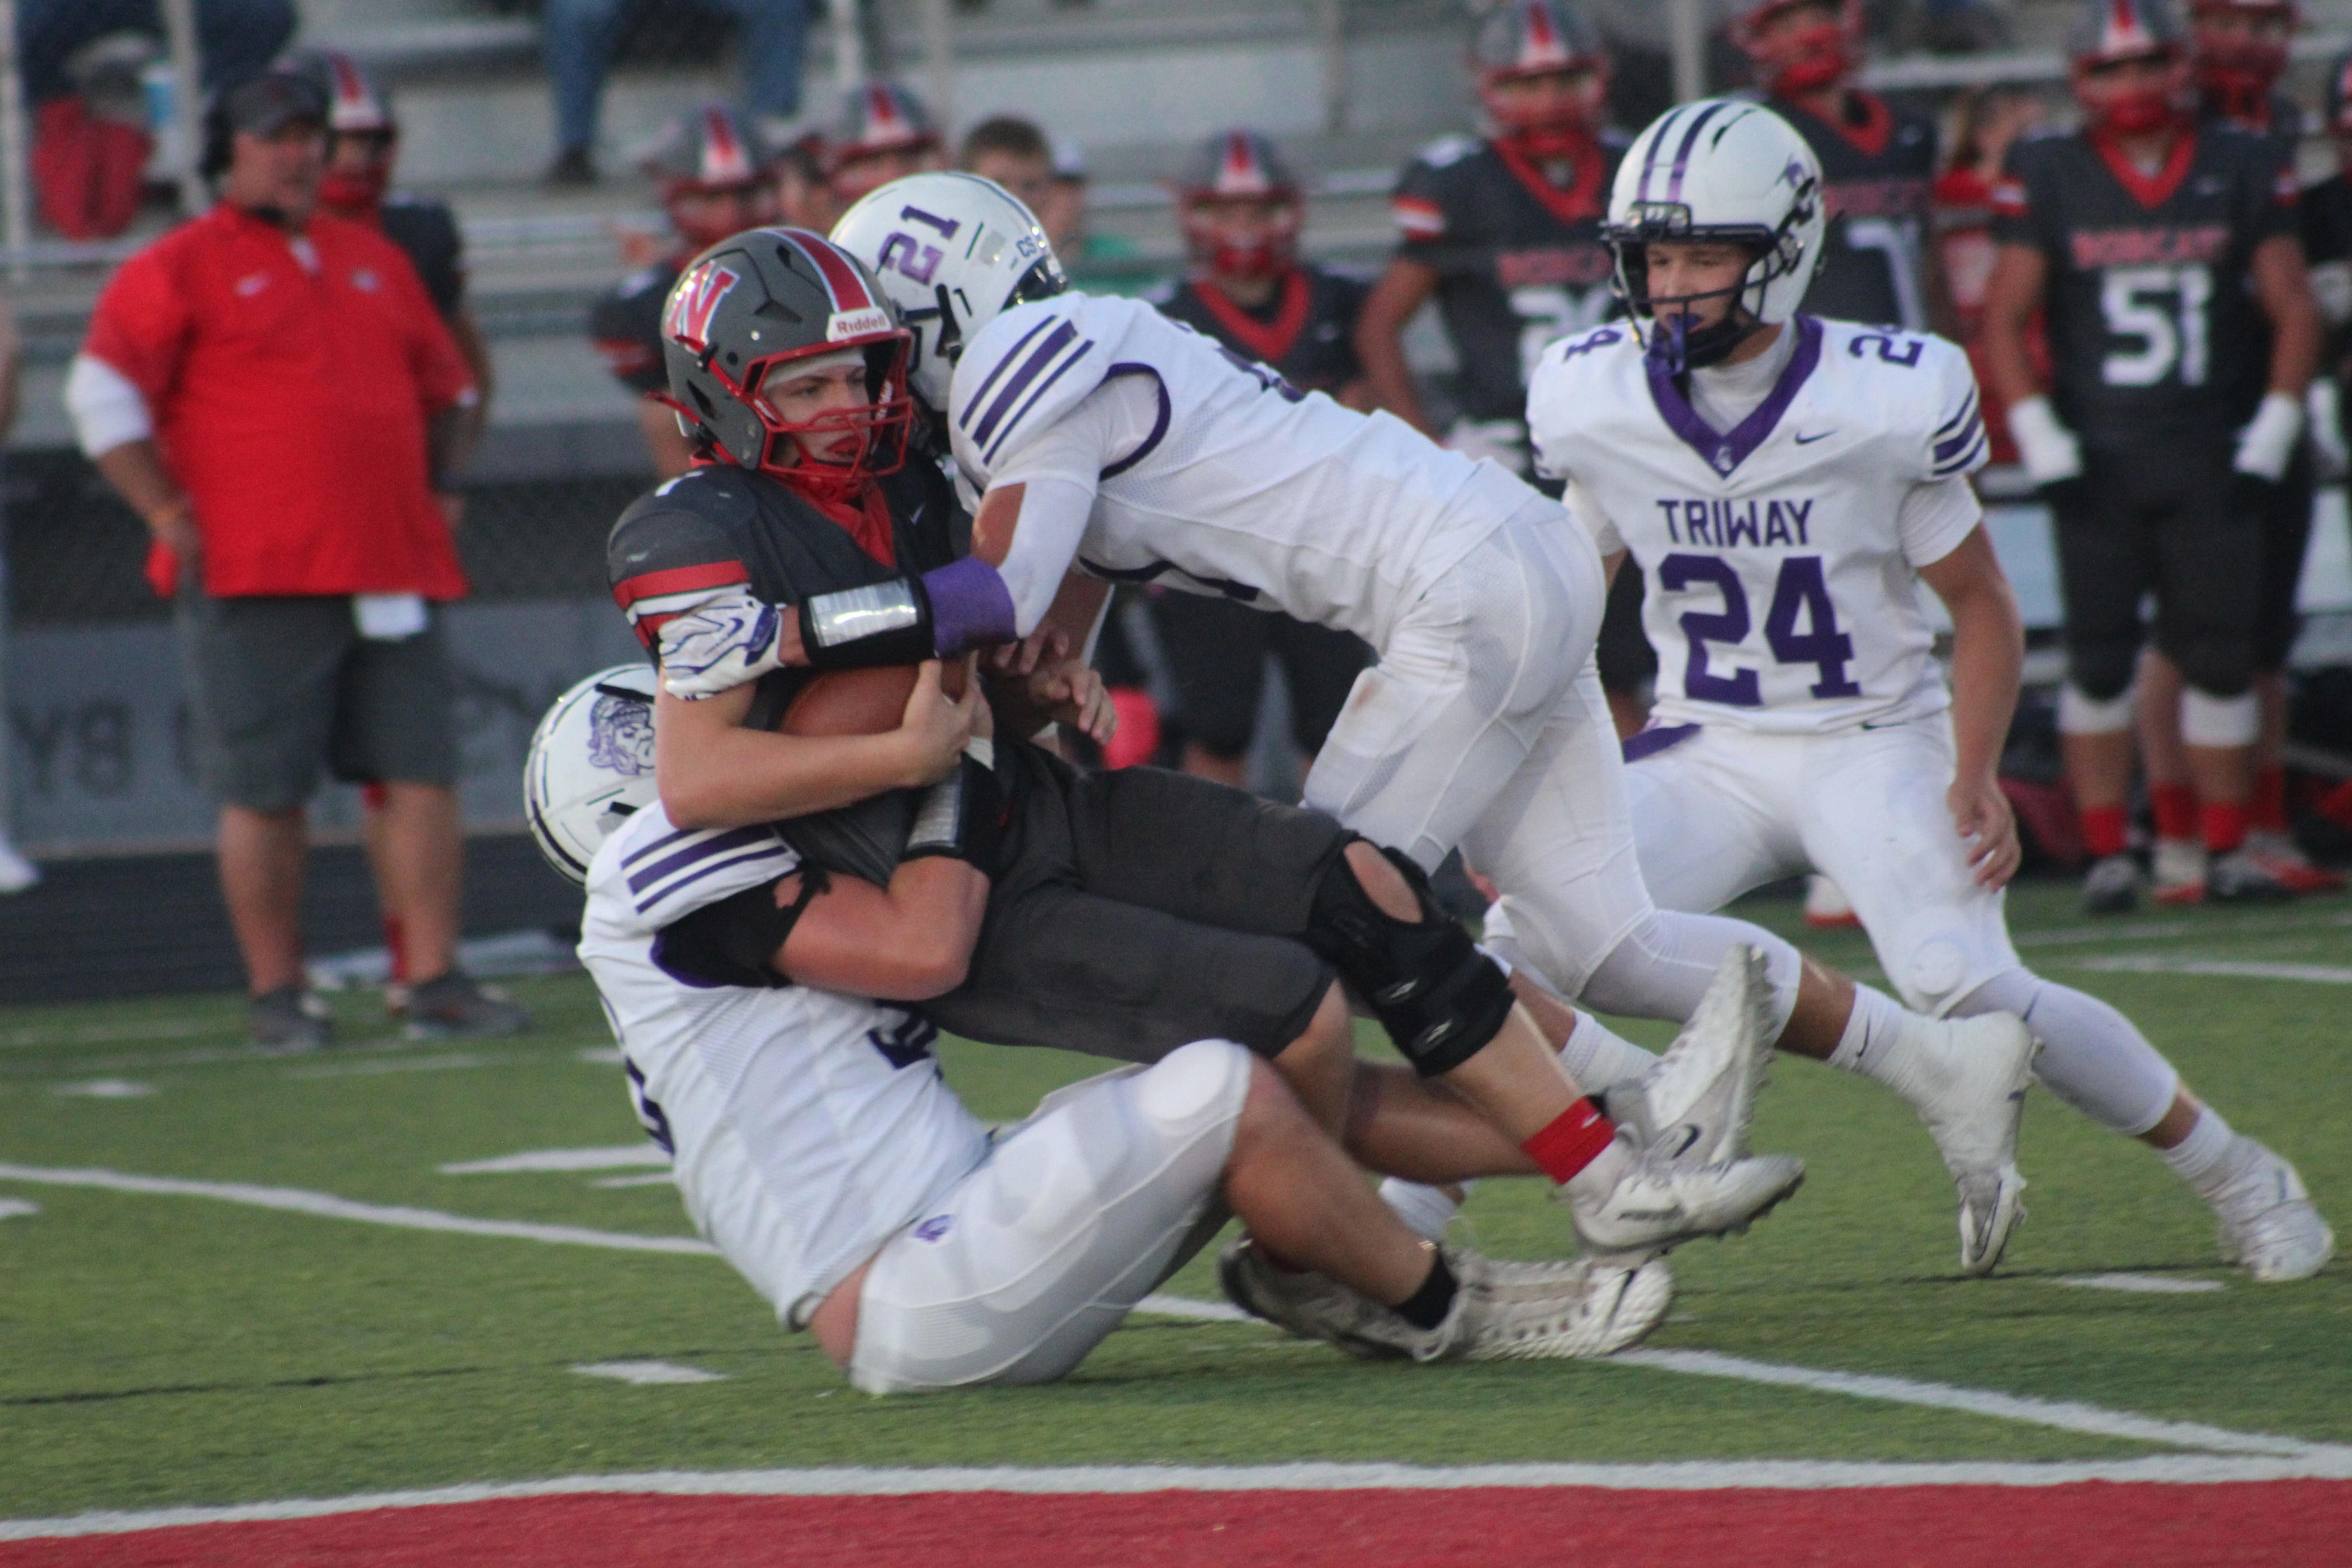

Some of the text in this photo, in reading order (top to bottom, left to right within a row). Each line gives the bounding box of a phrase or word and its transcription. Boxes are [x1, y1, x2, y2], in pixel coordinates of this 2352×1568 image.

[878, 205, 961, 287] 21
[665, 259, 741, 352] N
[837, 314, 886, 334] Riddell
[2100, 267, 2212, 386] 51
[1656, 498, 1814, 547] TRIWAY
[1658, 552, 1862, 706] 24
